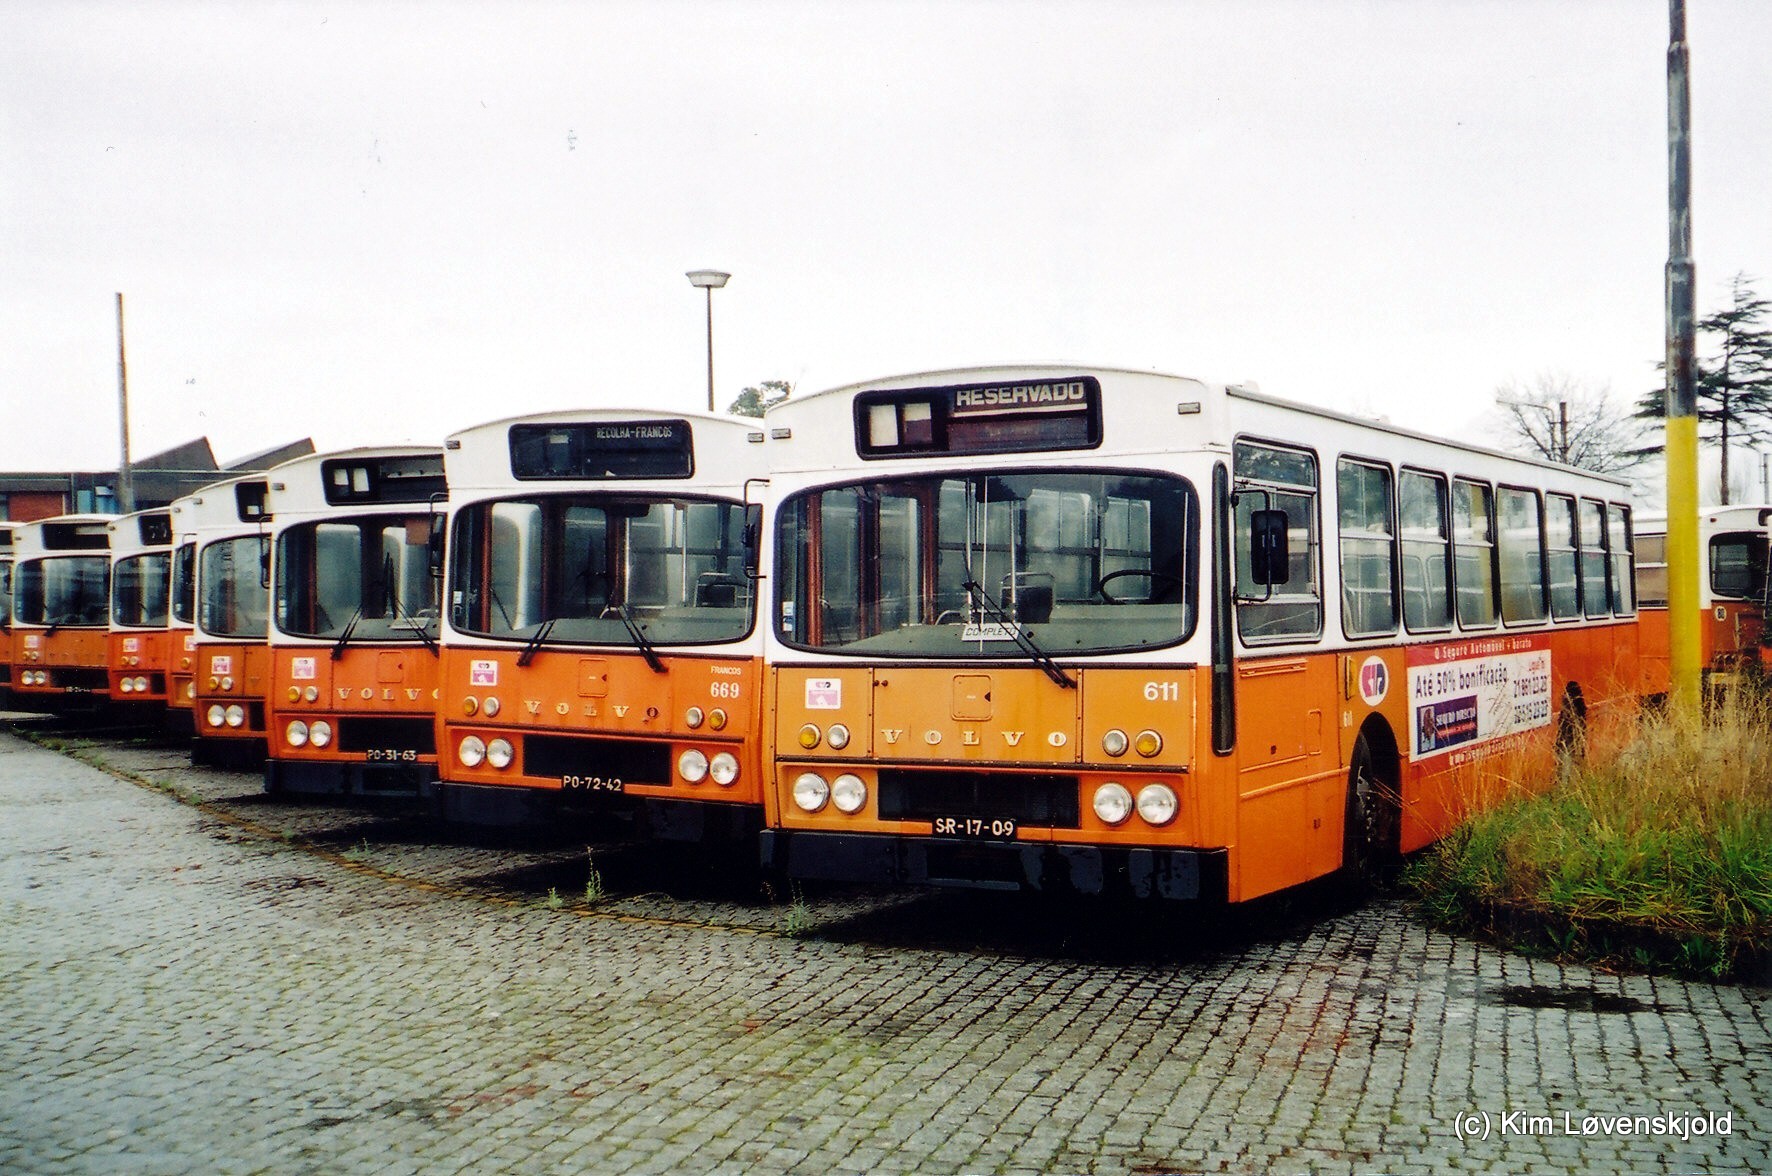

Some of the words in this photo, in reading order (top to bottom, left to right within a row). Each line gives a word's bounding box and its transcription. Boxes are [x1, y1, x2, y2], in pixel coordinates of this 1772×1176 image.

[956, 382, 1085, 407] RESERVADO
[710, 665, 741, 676] FRANCOS
[1415, 673, 1433, 698] Até
[1436, 670, 1456, 695] 50%
[1459, 662, 1508, 690] bonificação
[710, 682, 740, 699] 669
[1143, 681, 1179, 701] 611
[524, 699, 660, 719] VOLVO
[881, 728, 1067, 748] VOLVO
[366, 749, 417, 761] PO-31-63
[563, 775, 623, 793] PO-72-42
[935, 817, 1015, 837] SR-17-09
